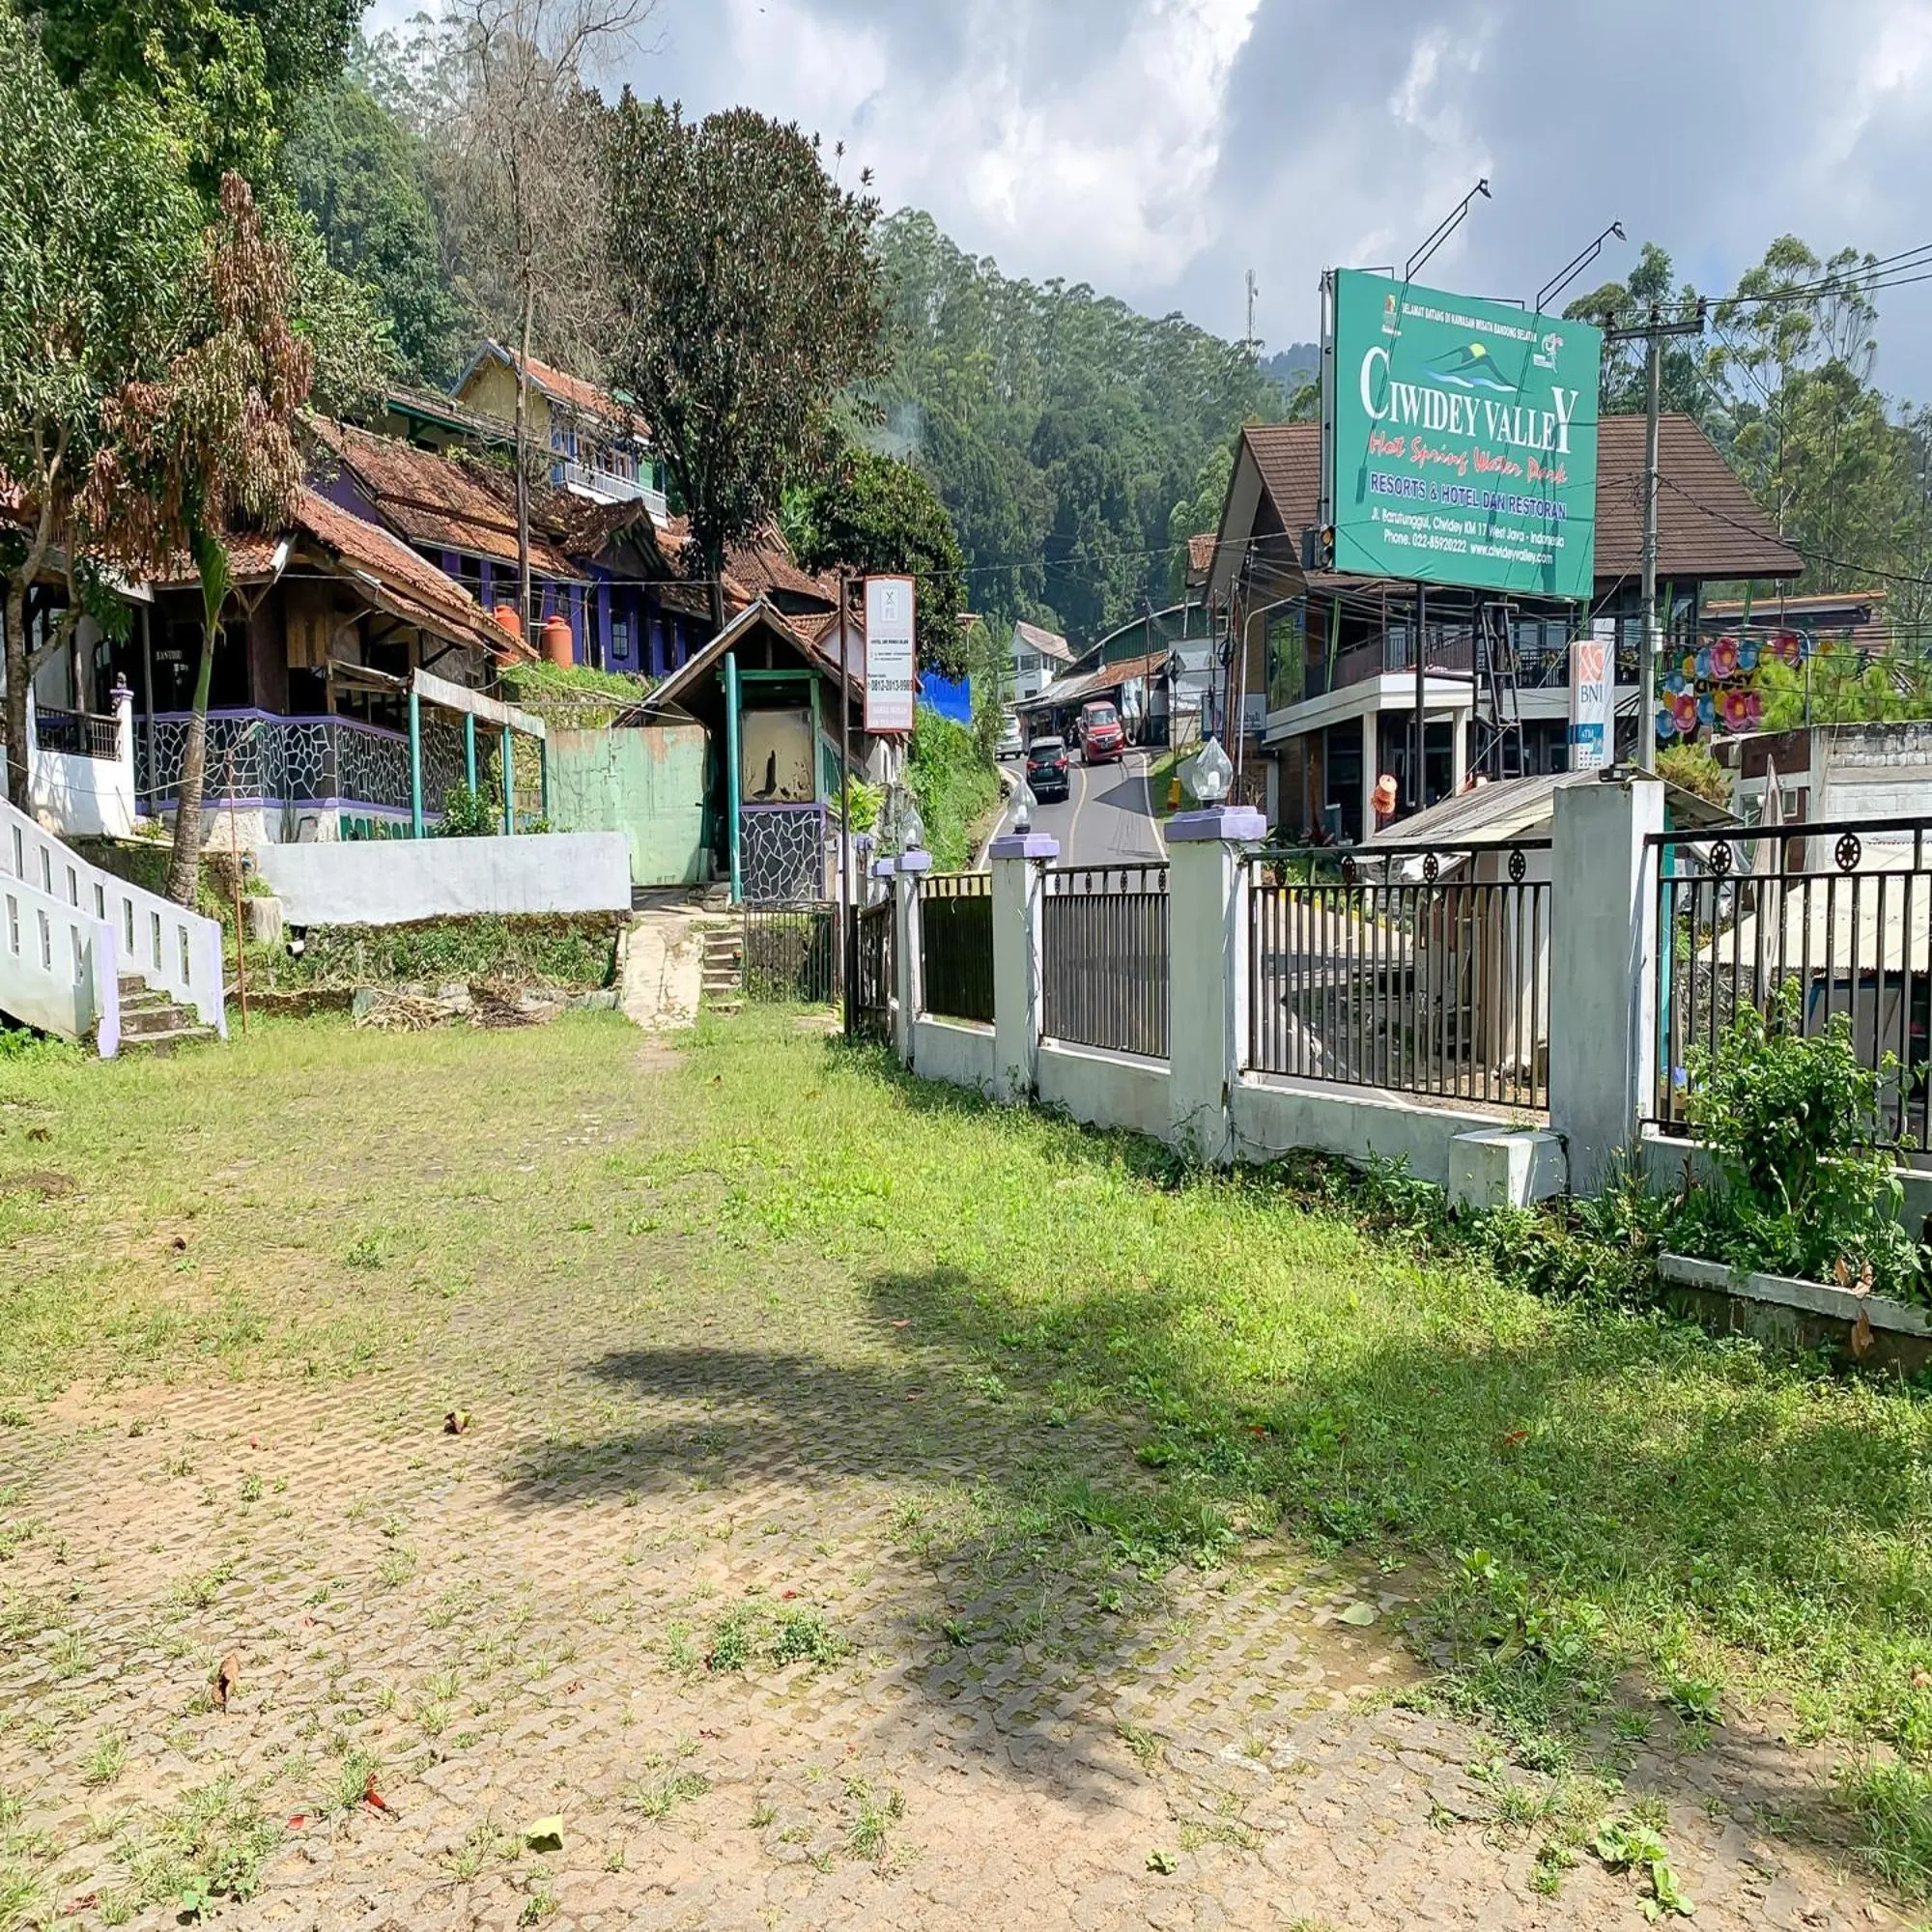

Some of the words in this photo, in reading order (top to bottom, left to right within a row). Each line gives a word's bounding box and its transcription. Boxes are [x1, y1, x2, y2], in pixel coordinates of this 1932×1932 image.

[1360, 346, 1480, 437] CIWIDEY
[1485, 386, 1579, 454] VALLEY
[1370, 431, 1406, 458] Hot
[1409, 436, 1468, 476] Spring
[1473, 446, 1522, 477] Water
[1527, 455, 1568, 484] Park
[1371, 471, 1426, 500] RESORTS
[1430, 481, 1438, 501] &
[1441, 483, 1480, 508] HOTEL
[1482, 490, 1505, 512] DAN
[1508, 495, 1567, 521] RESTORAN
[1463, 521, 1476, 534] KM
[1478, 522, 1487, 536] 17
[1489, 524, 1506, 539] West
[1506, 527, 1524, 542] Java
[1530, 530, 1564, 548] Indonesia
[1580, 684, 1603, 703] BNI
